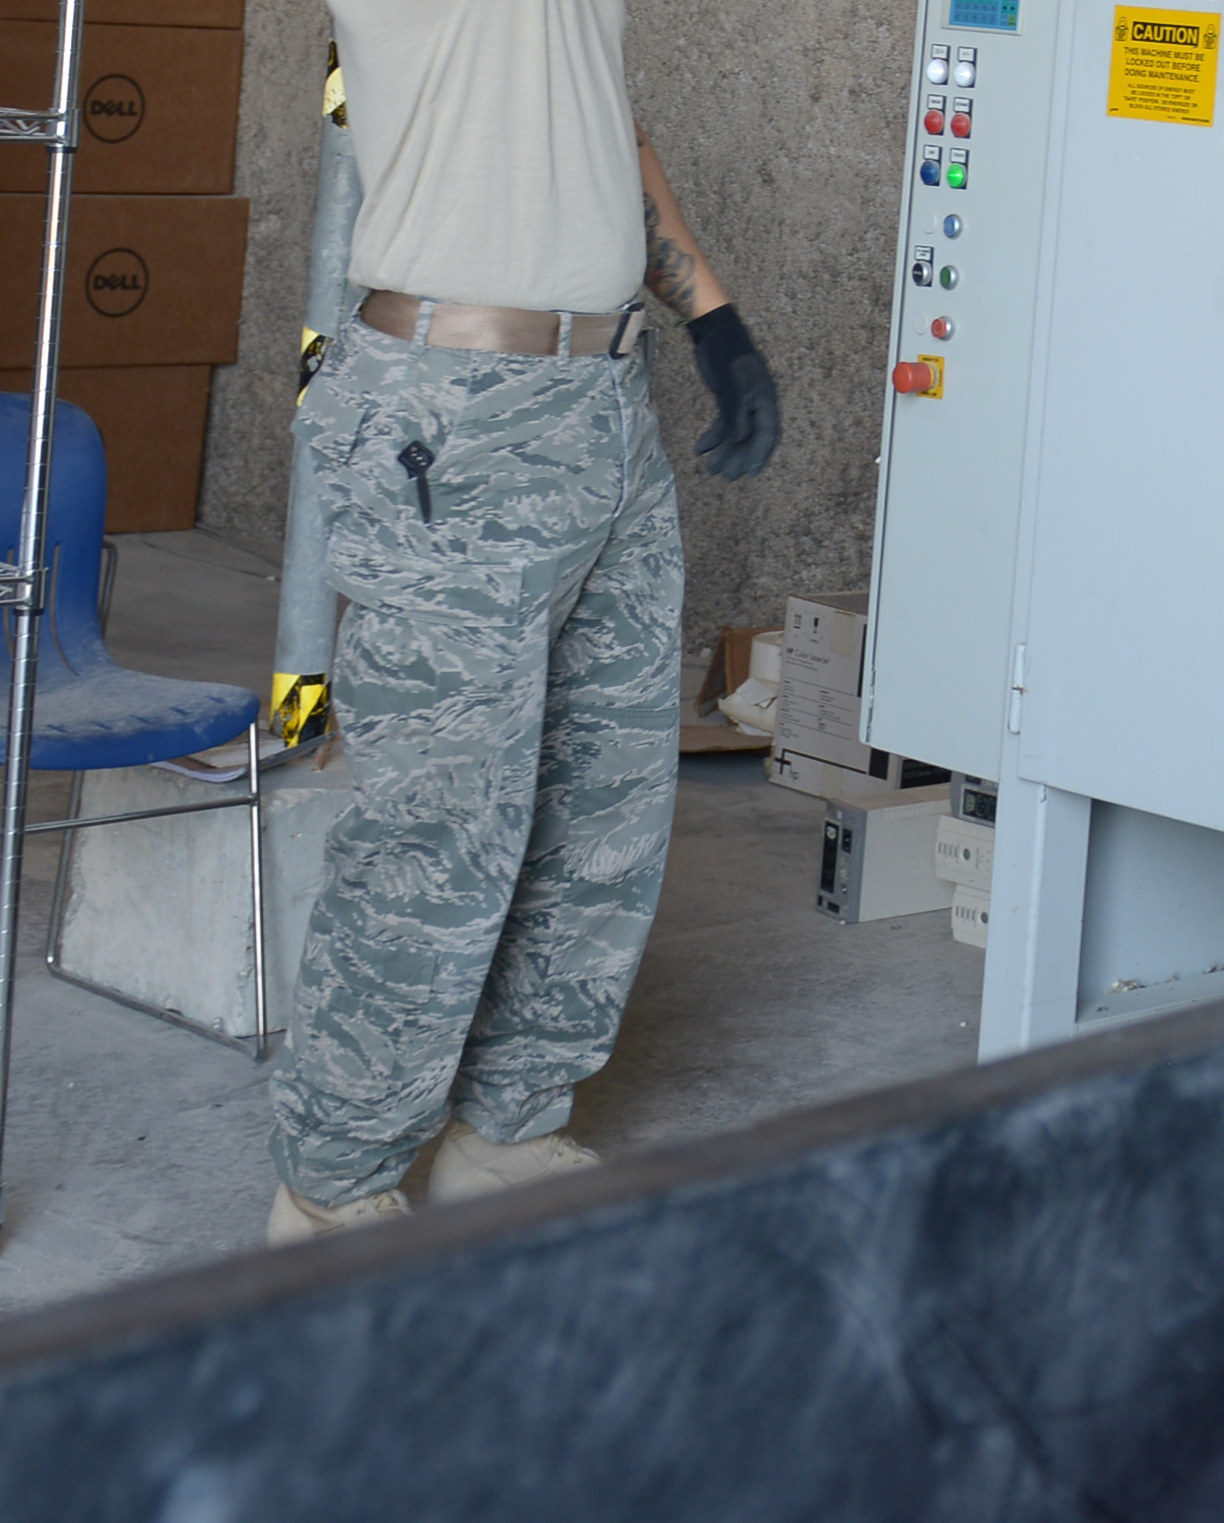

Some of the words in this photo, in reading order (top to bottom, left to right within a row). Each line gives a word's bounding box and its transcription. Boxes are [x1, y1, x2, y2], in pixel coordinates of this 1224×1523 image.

[1132, 23, 1198, 44] CAUTION
[1124, 46, 1139, 56] THIS
[1141, 48, 1172, 58] MACHINE
[1174, 51, 1193, 60] MUST
[1194, 52, 1204, 61] BE
[1125, 58, 1154, 68] LOCKED
[1156, 61, 1170, 69] OUT
[1172, 62, 1200, 72] BEFORE
[1124, 68, 1147, 78] DOING
[1148, 70, 1200, 83] MAINTENANCE.
[90, 100, 137, 117] DELL
[93, 274, 142, 291] DELL
